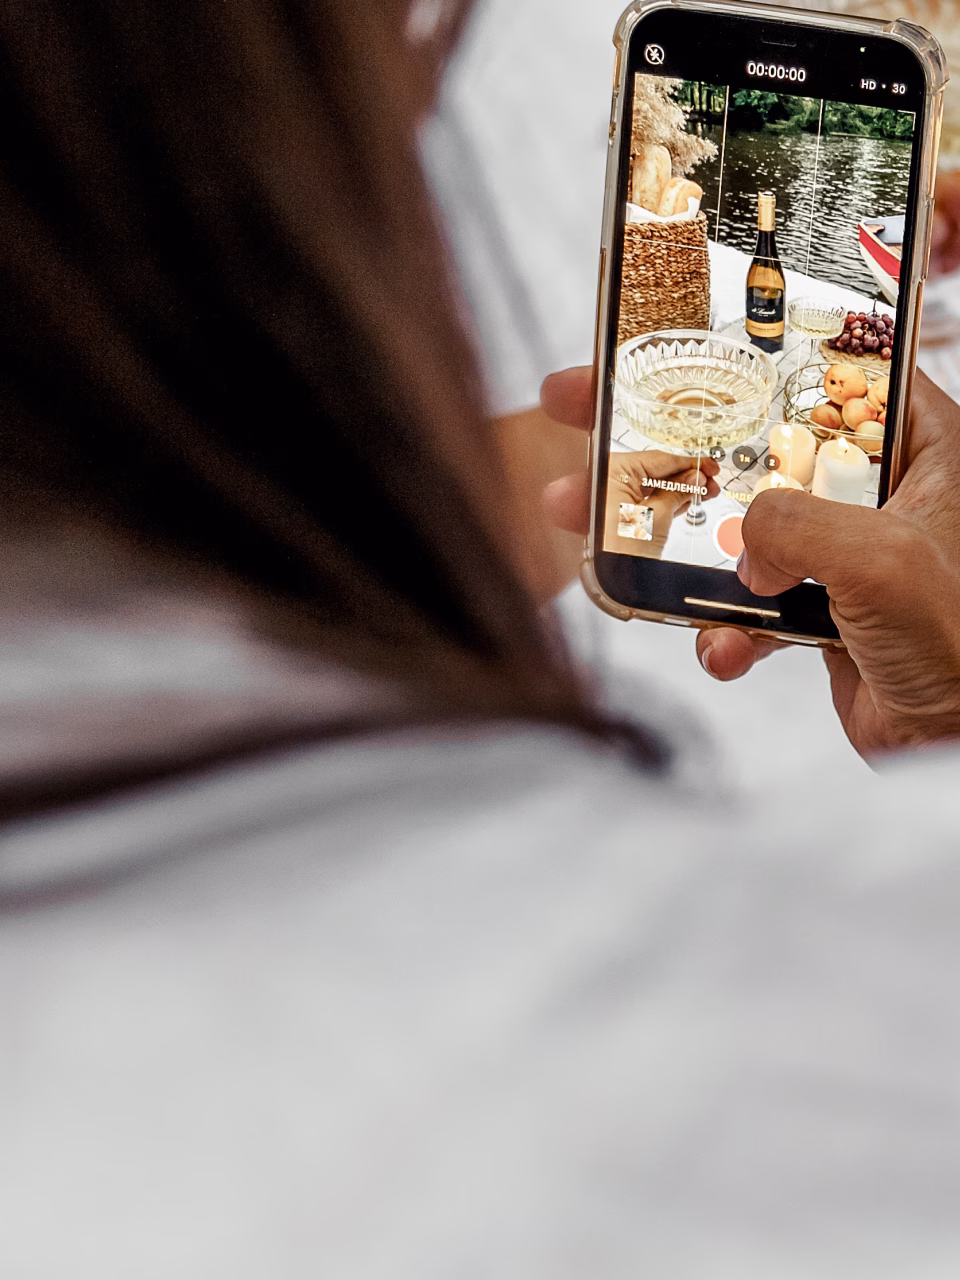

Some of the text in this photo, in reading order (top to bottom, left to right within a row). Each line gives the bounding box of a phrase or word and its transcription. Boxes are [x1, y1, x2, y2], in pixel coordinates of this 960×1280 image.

[747, 61, 807, 82] 00:00:00
[860, 78, 906, 95] HD 30
[769, 458, 776, 467] 2
[641, 477, 708, 497] ЗАМЕДЛЕННО
